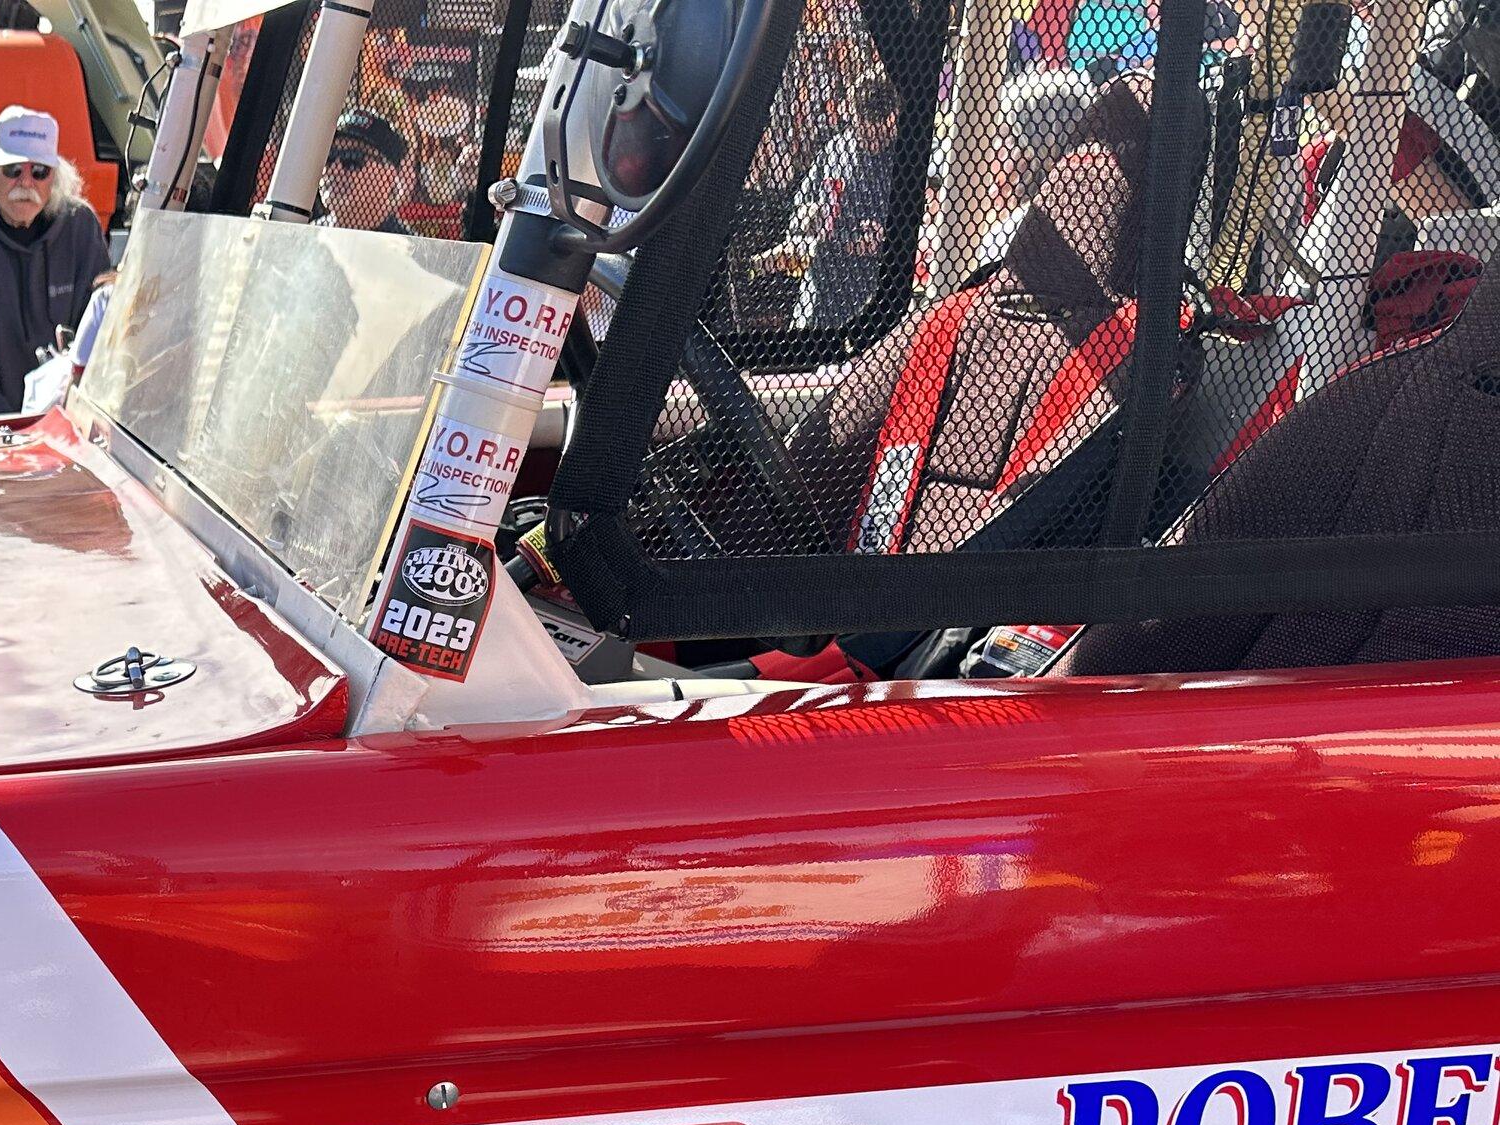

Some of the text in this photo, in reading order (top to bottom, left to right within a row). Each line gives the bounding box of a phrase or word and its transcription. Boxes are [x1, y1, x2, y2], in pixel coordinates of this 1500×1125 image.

[414, 548, 482, 580] MINT
[414, 564, 473, 595] 400
[381, 598, 477, 652] 2023
[376, 632, 466, 671] PRE-TECH
